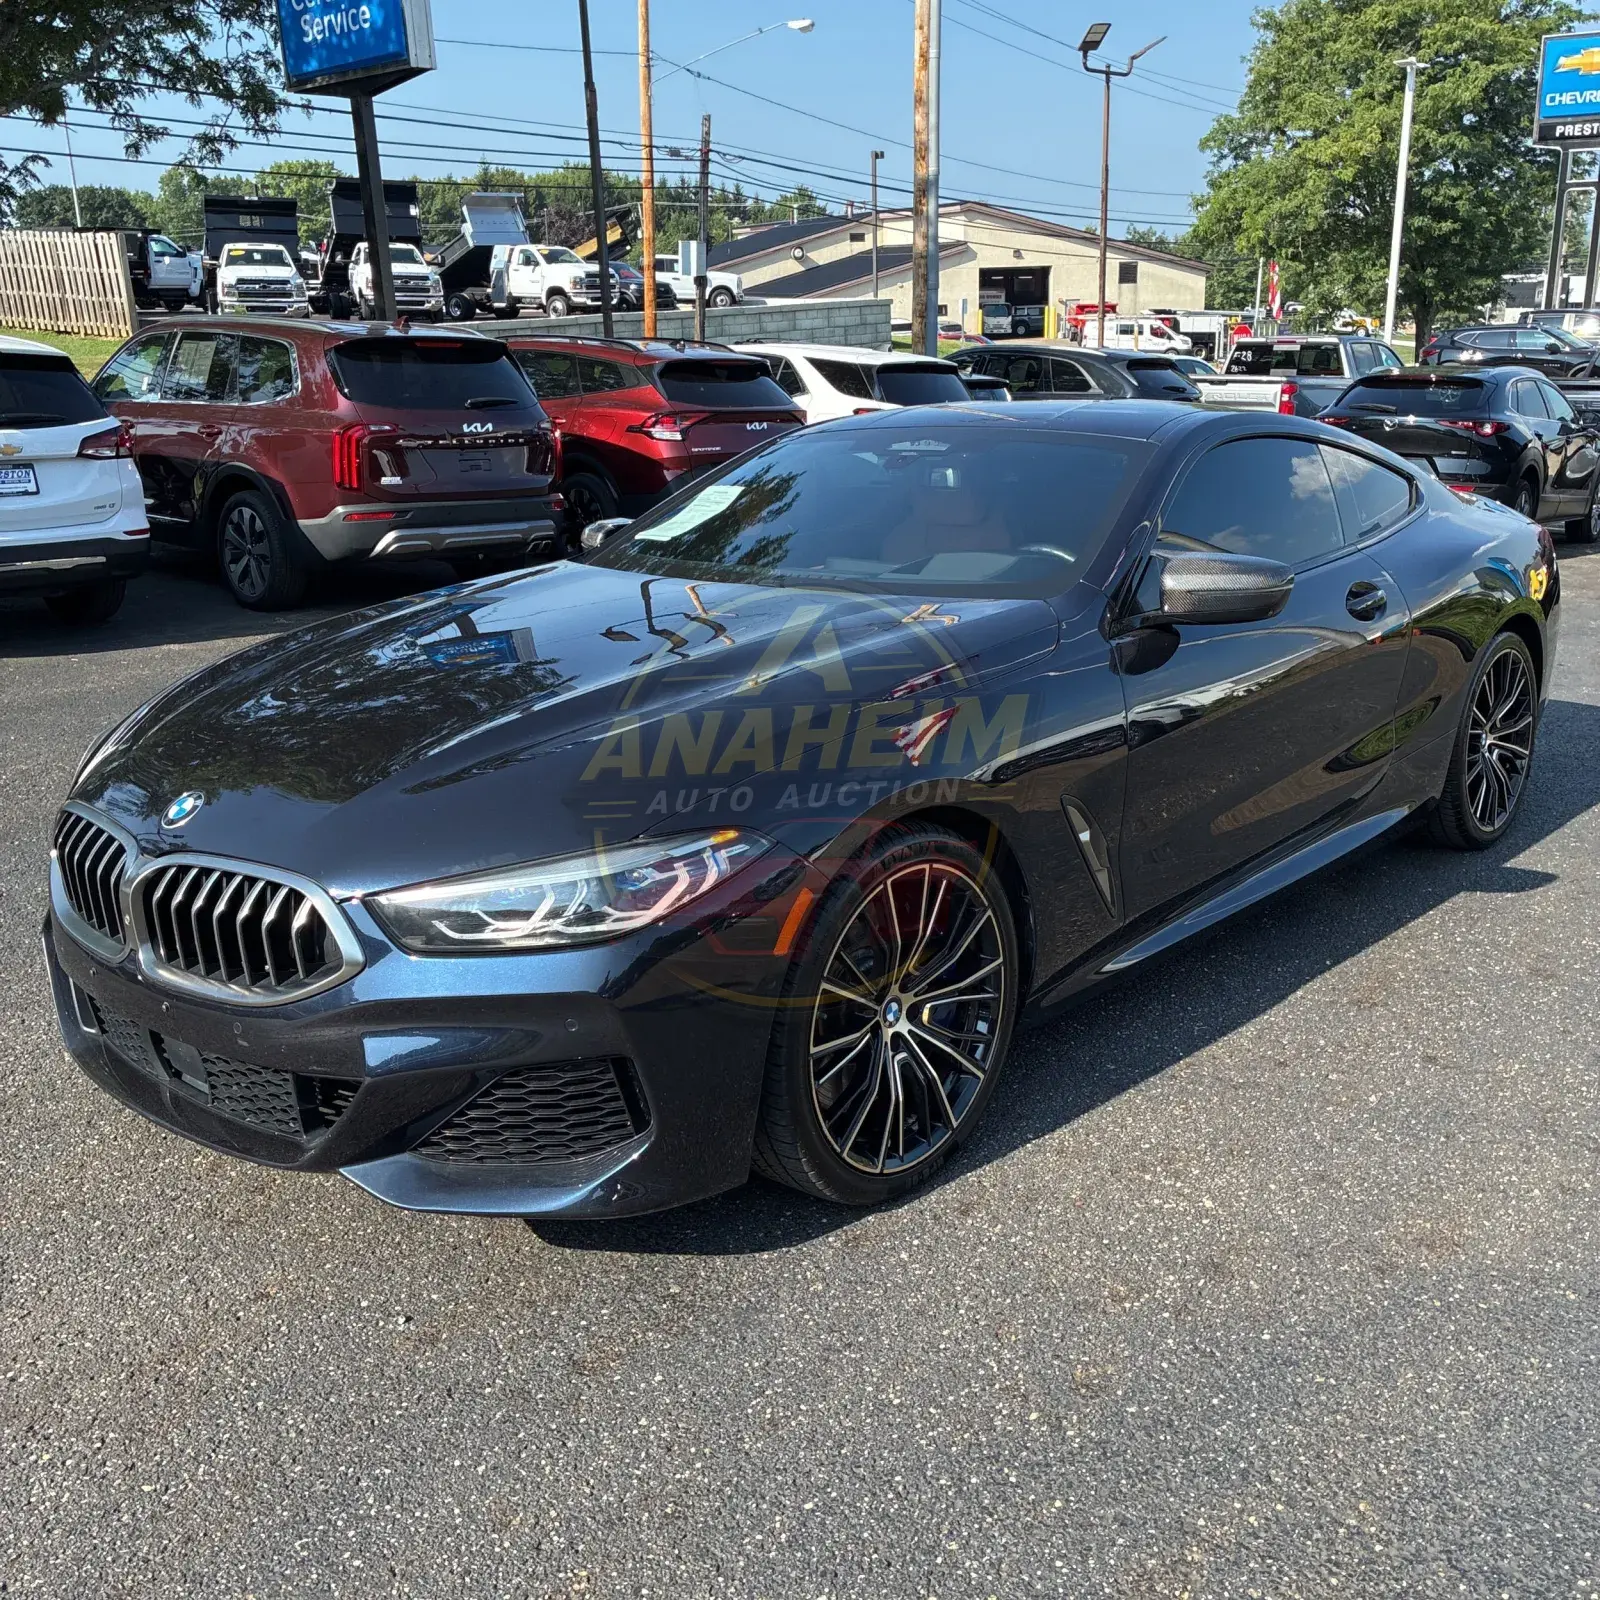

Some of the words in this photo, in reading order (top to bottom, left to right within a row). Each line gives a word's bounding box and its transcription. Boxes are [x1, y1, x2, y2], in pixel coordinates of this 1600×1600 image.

[300, 4, 371, 42] Service
[1555, 123, 1600, 137] PREST
[462, 423, 493, 433] KIA
[746, 422, 768, 430] KIA
